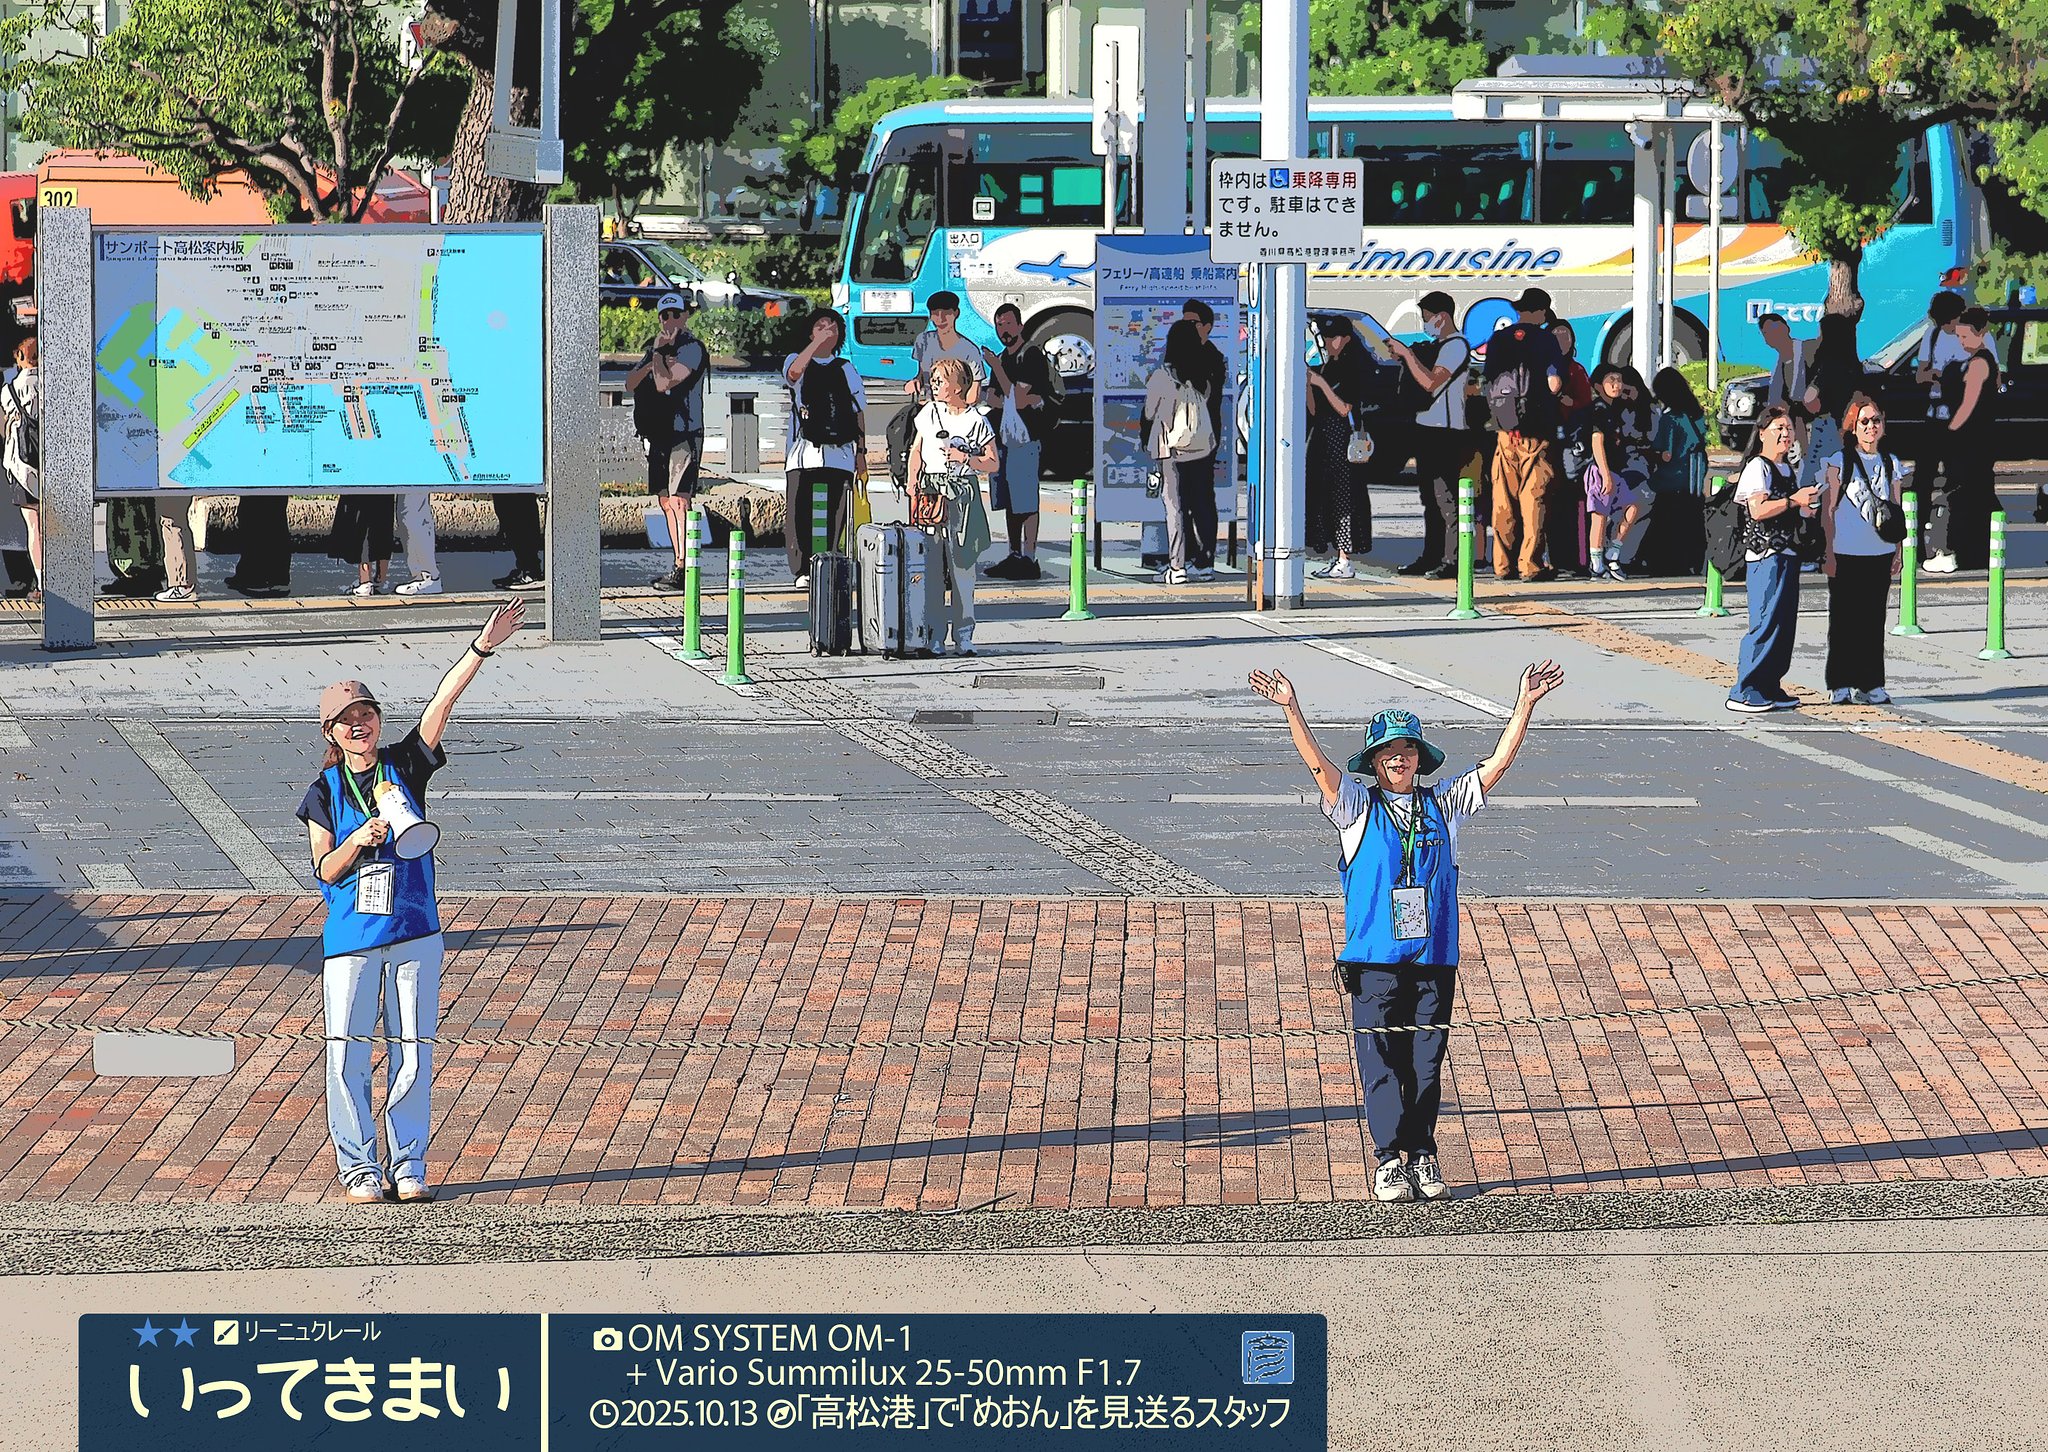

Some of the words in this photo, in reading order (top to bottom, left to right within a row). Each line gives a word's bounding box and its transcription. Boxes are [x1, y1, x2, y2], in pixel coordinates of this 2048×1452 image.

[1219, 171, 1267, 189] 枠内は
[1292, 171, 1357, 189] 乗降専用
[1218, 195, 1356, 214] です。駐車はでき
[1219, 221, 1279, 238] ません。
[105, 240, 245, 255] サンポート高松案内板
[1318, 238, 1563, 272] imousine
[1102, 267, 1185, 280] フェリー/高速船
